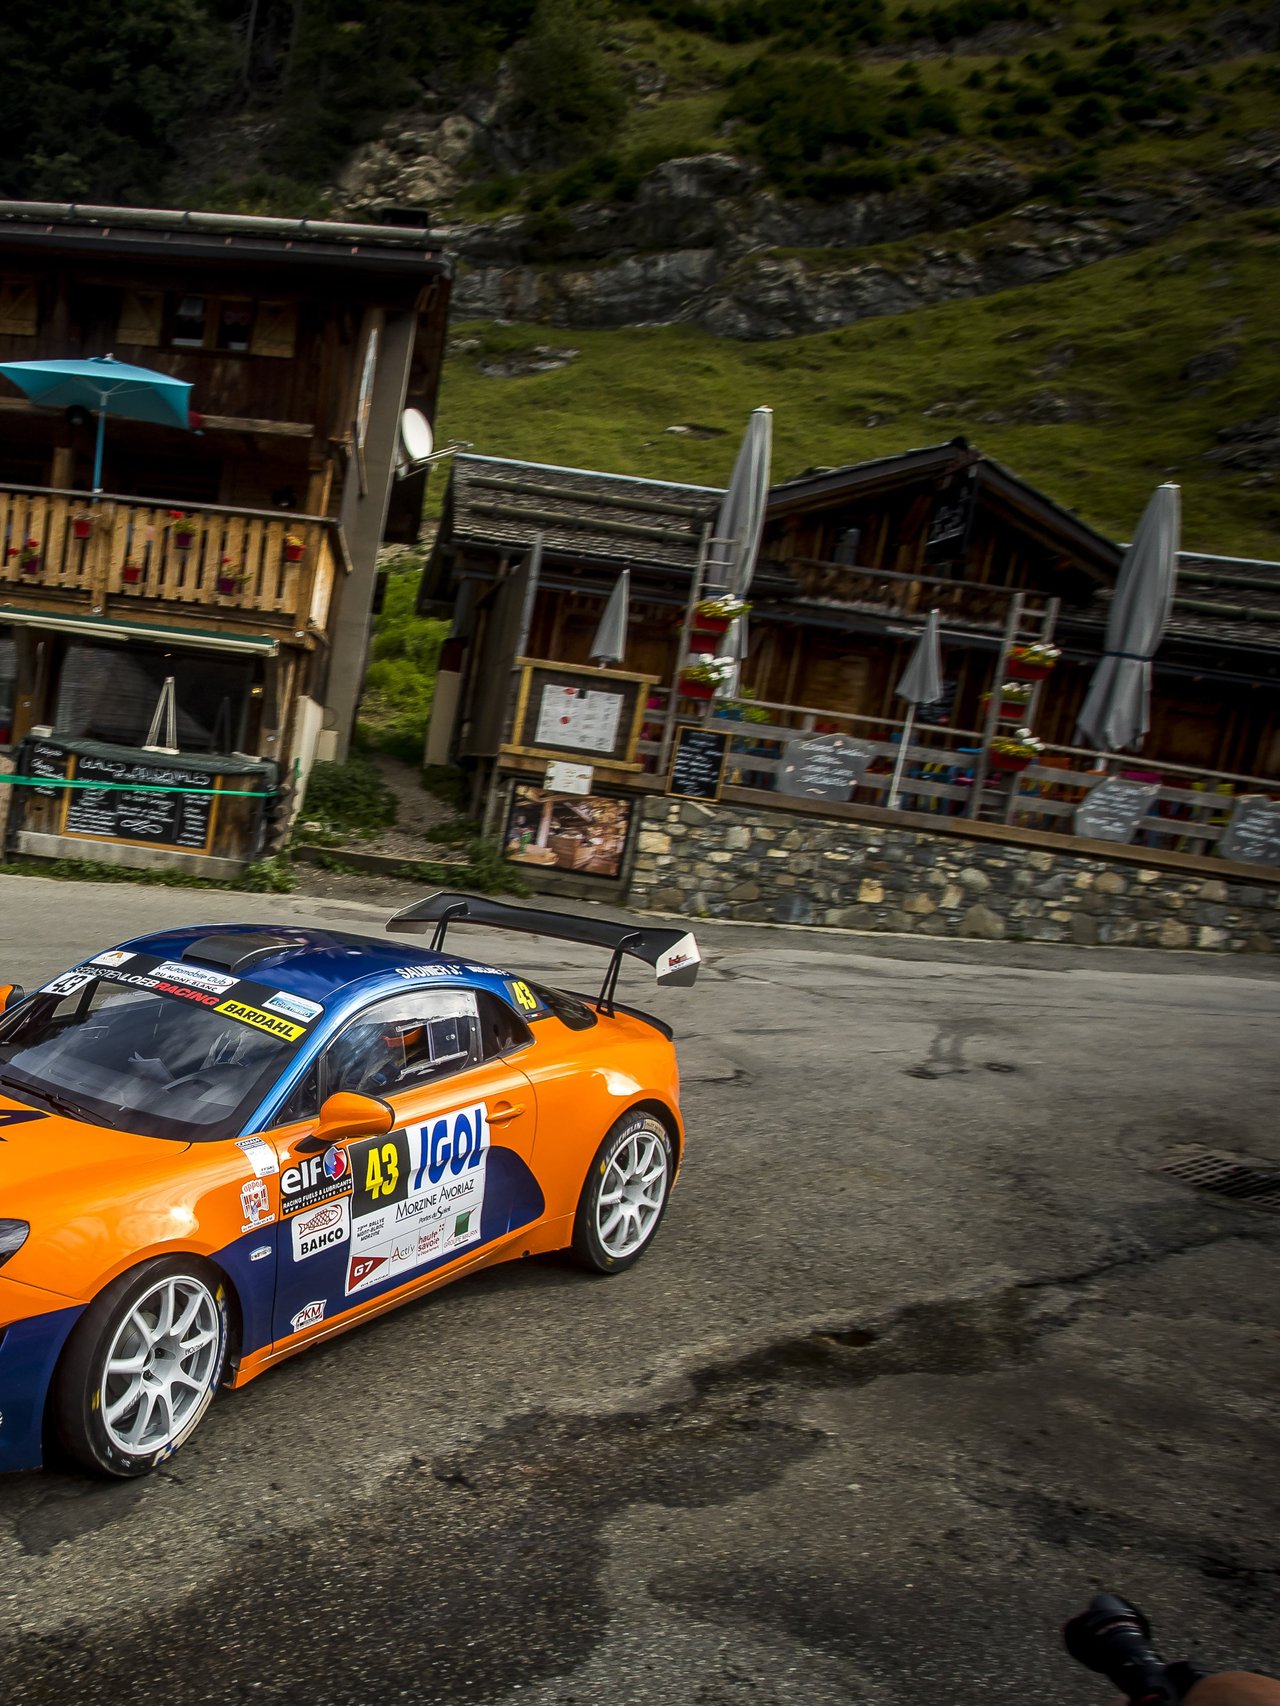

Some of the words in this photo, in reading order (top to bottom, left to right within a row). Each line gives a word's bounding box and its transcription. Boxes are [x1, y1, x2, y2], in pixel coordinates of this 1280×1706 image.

[52, 974, 88, 994] 43
[163, 965, 207, 980] Automobile
[207, 974, 227, 985] Club
[168, 975, 218, 992] MONT-BLANC
[511, 981, 537, 1011] 43
[223, 1003, 294, 1038] BARDAHL
[414, 1109, 485, 1191] IGOL
[281, 1156, 323, 1195] elf
[365, 1143, 399, 1200] 43
[282, 1198, 302, 1210] RACING
[302, 1192, 319, 1202] FUELS
[322, 1178, 352, 1195] LUBRICANTS
[396, 1193, 437, 1220] MORZINE
[438, 1178, 475, 1201] AVORIAZ
[368, 1217, 385, 1228] RALLYE
[300, 1228, 344, 1256] BAHCO
[354, 1260, 374, 1277] G7
